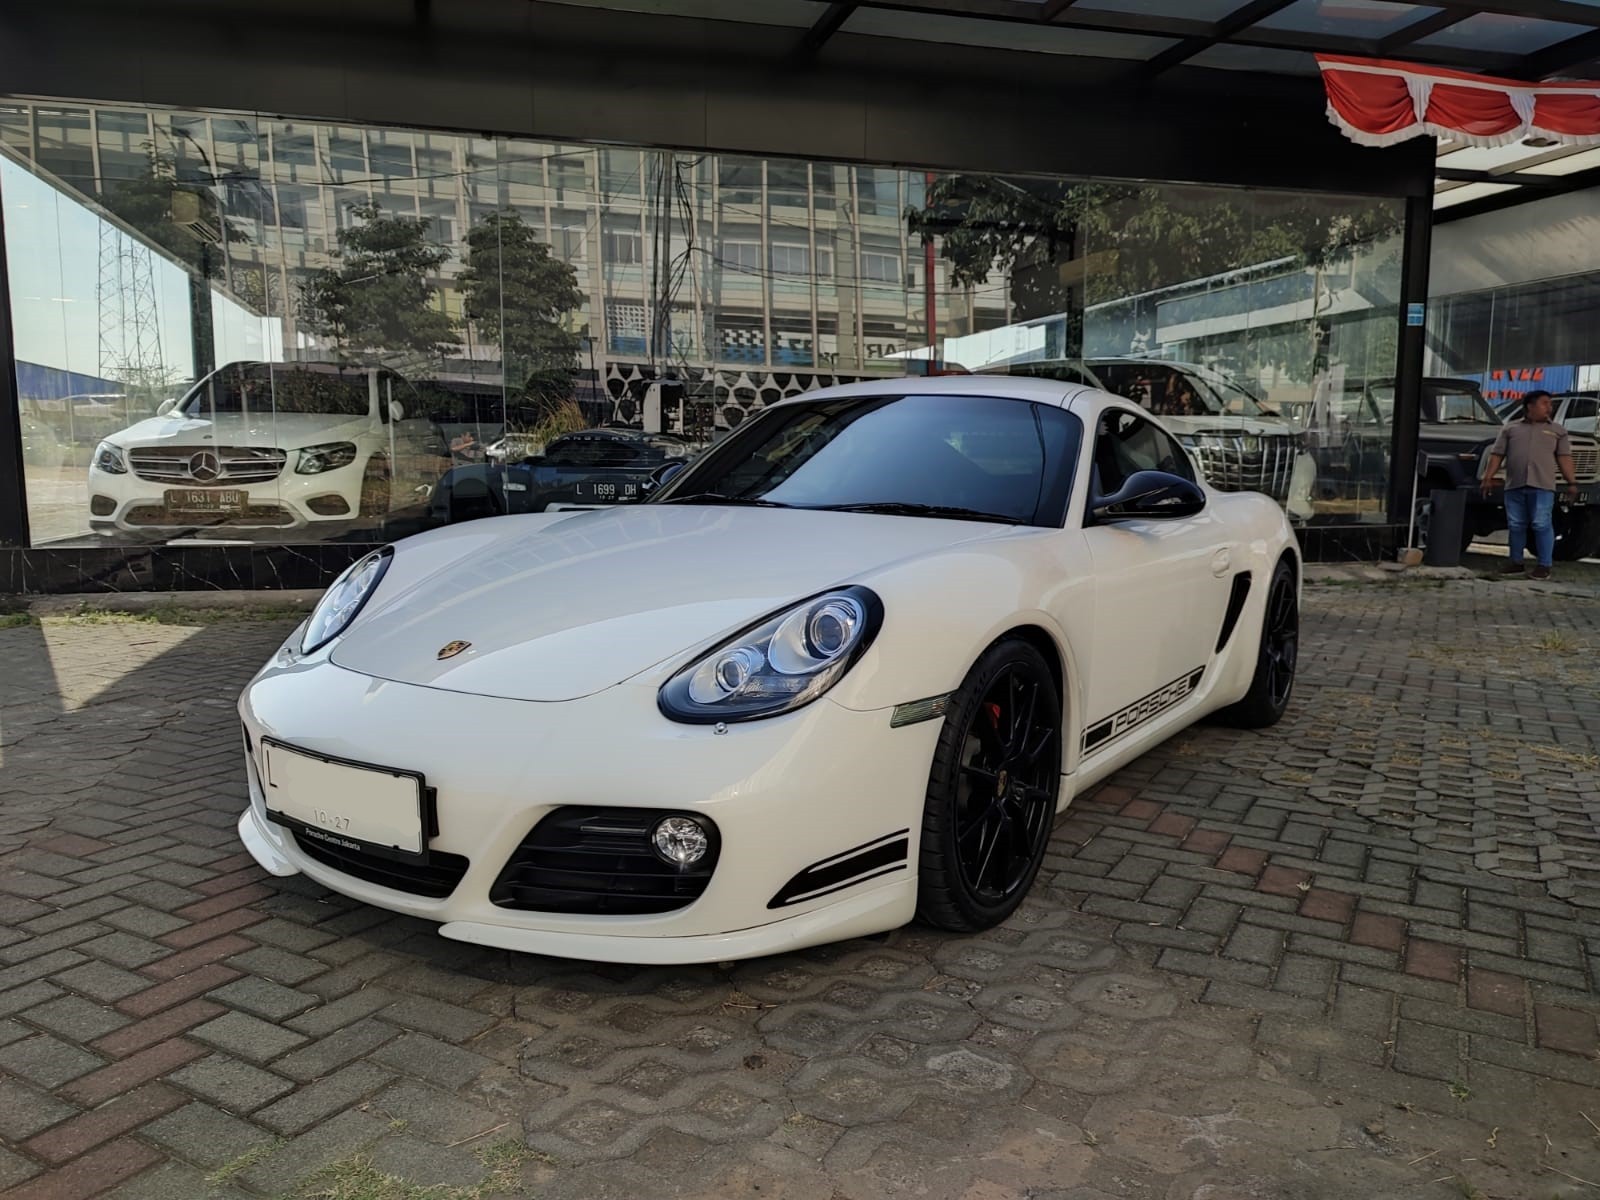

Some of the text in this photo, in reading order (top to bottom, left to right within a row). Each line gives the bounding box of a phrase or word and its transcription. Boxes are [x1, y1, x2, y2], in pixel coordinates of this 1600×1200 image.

[170, 491, 177, 503] L
[185, 491, 211, 503] 1631
[576, 483, 583, 495] L
[593, 483, 615, 495] 1699
[1114, 678, 1188, 733] PORSCHE
[266, 749, 278, 788] L
